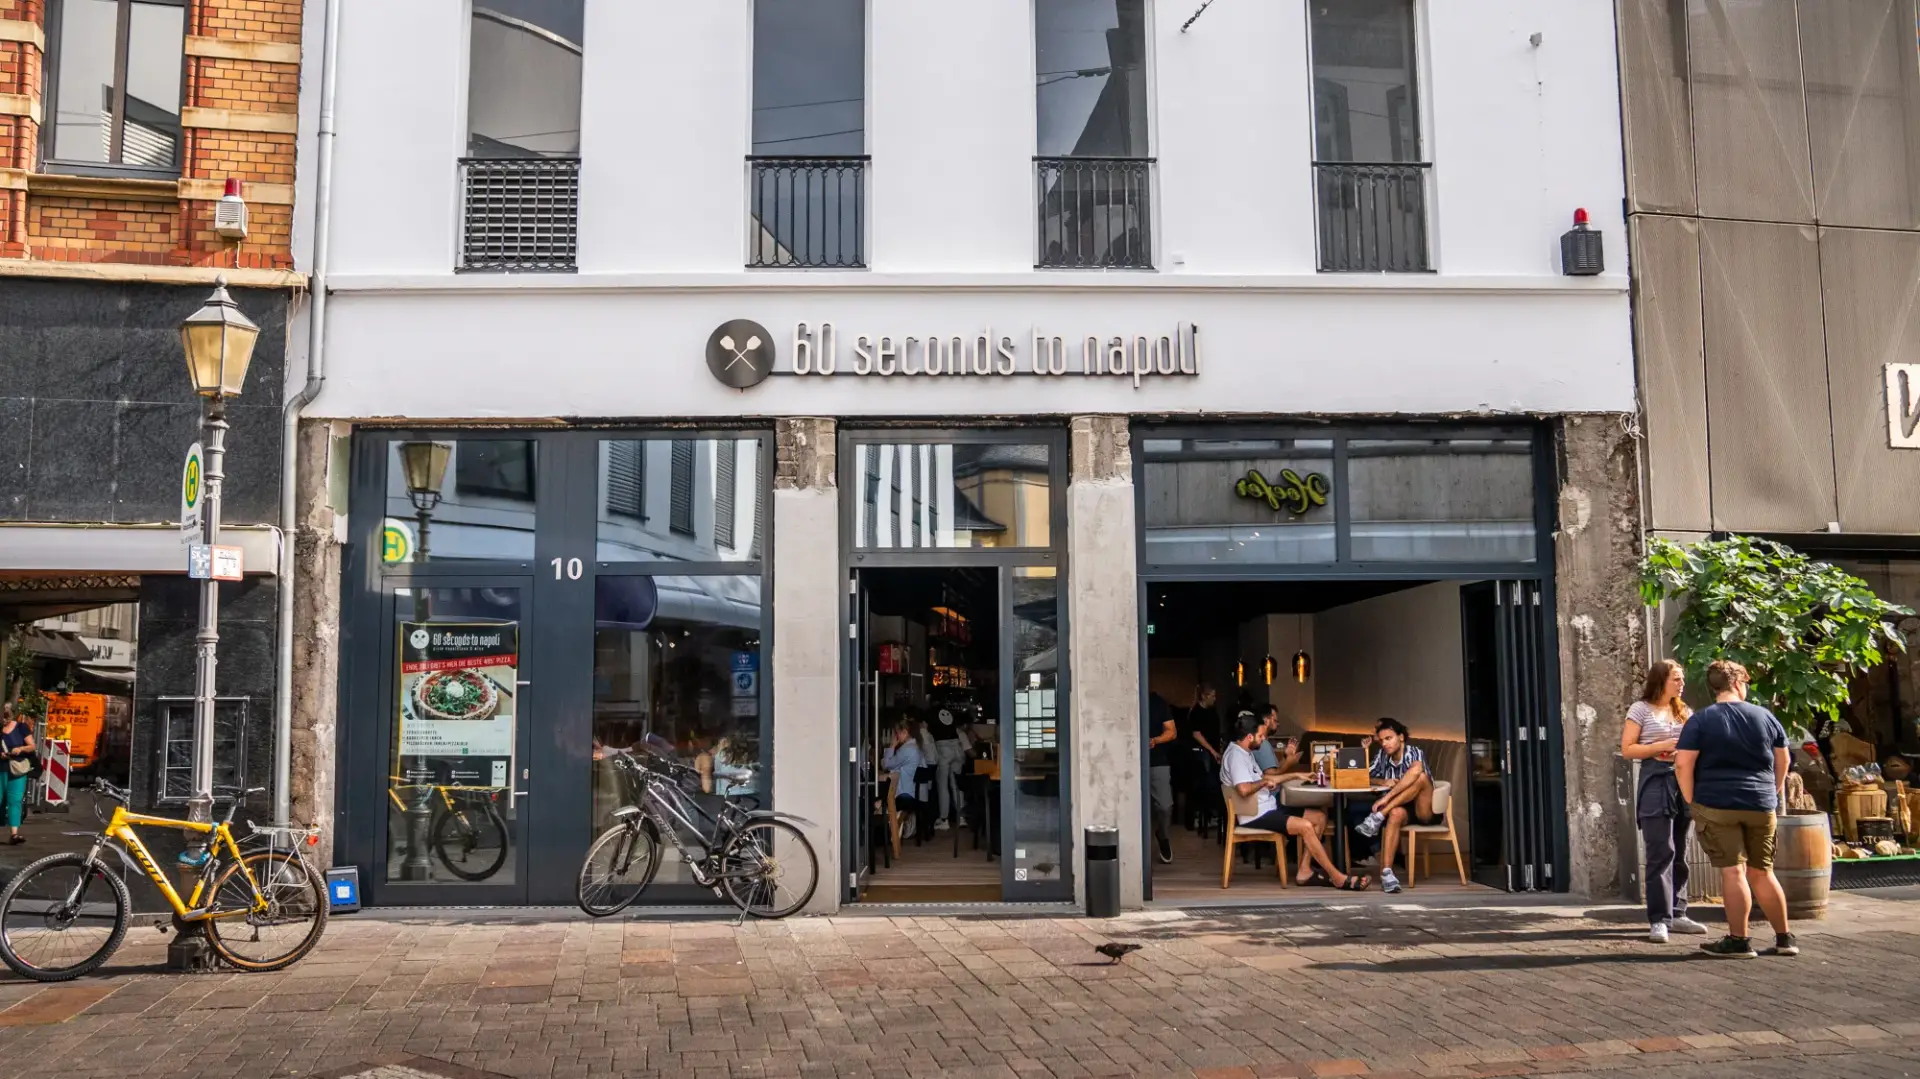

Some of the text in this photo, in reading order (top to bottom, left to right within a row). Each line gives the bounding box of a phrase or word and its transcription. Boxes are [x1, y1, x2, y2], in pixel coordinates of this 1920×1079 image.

[791, 321, 1199, 389] 60 seconds to napoli
[551, 557, 583, 580] 10
[433, 633, 500, 648] 60 seconds to napoli
[125, 838, 168, 886] SCOTT
